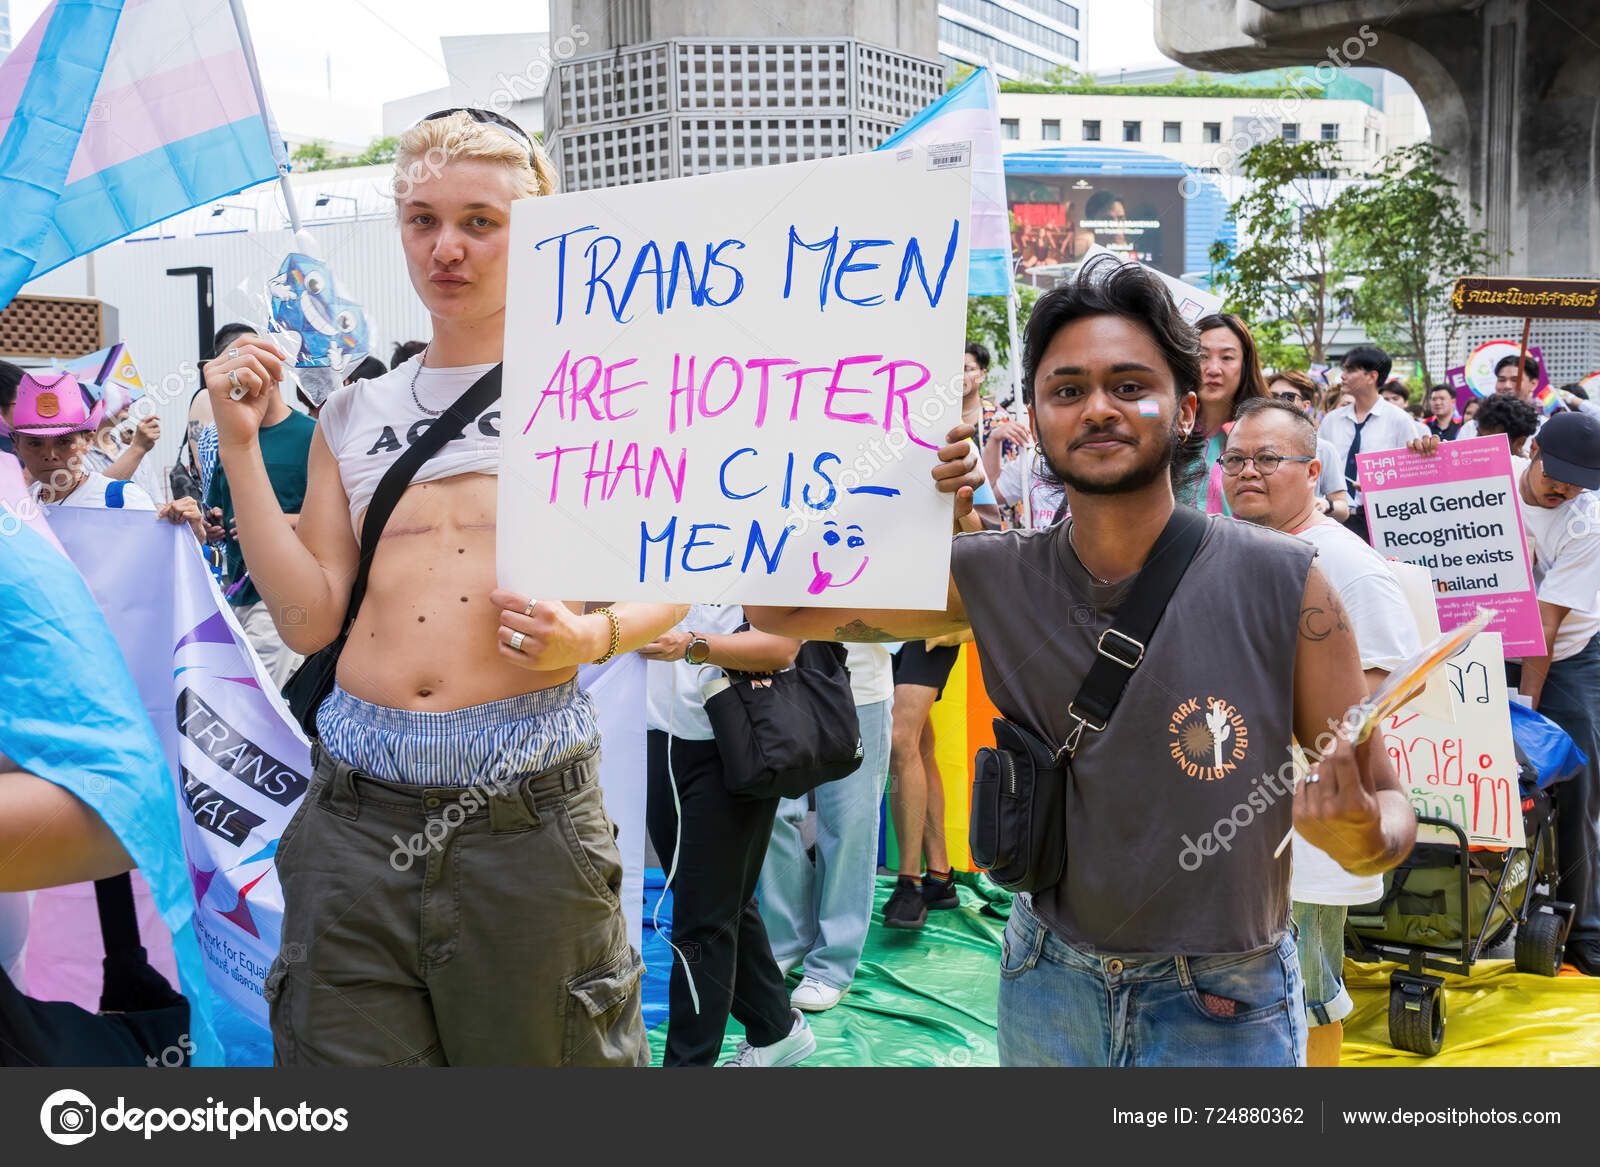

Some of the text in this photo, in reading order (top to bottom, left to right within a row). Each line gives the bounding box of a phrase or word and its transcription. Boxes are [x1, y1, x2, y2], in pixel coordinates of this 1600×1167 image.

[535, 219, 959, 325] TRANS MEN
[523, 350, 940, 451] ARE HOTTER
[536, 440, 687, 507] THAN
[1361, 456, 1396, 470] THAI
[1374, 490, 1507, 521] Legal Gender
[1383, 522, 1504, 548] Recognition
[640, 516, 796, 582] MEN
[1441, 553, 1463, 567] be
[1466, 549, 1514, 565] exists
[179, 698, 299, 798] TRANS
[1168, 696, 1248, 781] SAGUARO NATIONAL PARK
[223, 940, 238, 962] for
